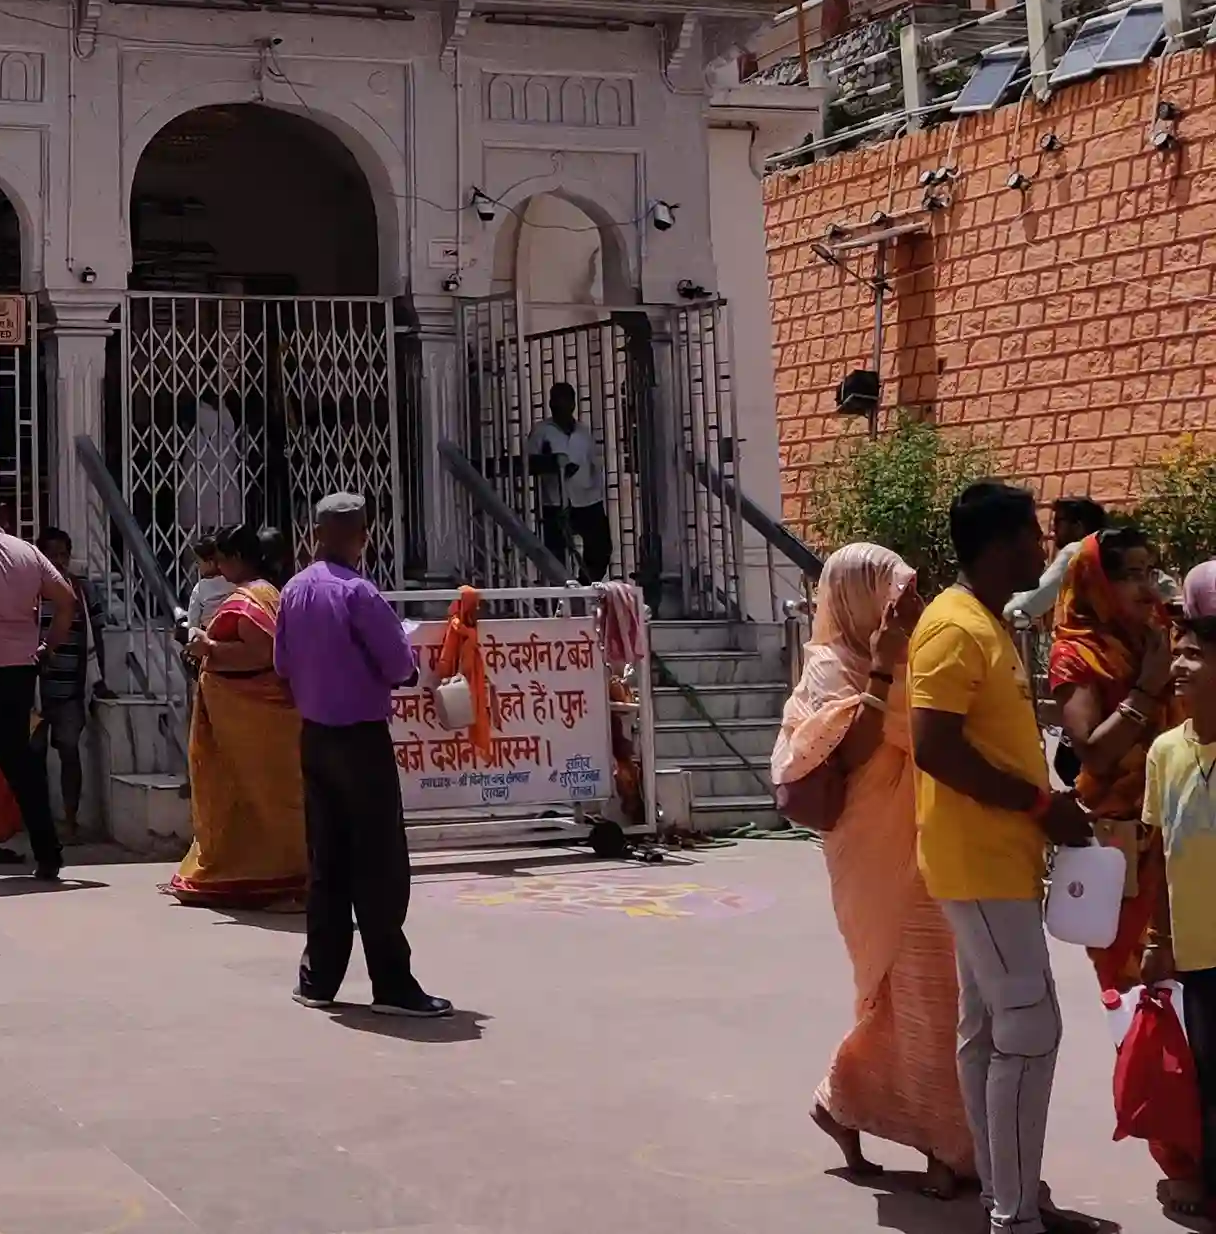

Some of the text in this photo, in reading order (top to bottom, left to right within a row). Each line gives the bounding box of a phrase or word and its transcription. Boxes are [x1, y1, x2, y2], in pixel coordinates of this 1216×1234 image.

[483, 634, 505, 674] के
[506, 633, 552, 674] दर्शन
[553, 640, 568, 672] 2
[567, 631, 595, 670] बजे
[390, 693, 421, 724] यन
[393, 732, 424, 773] बजे
[429, 731, 476, 772] दर्शन
